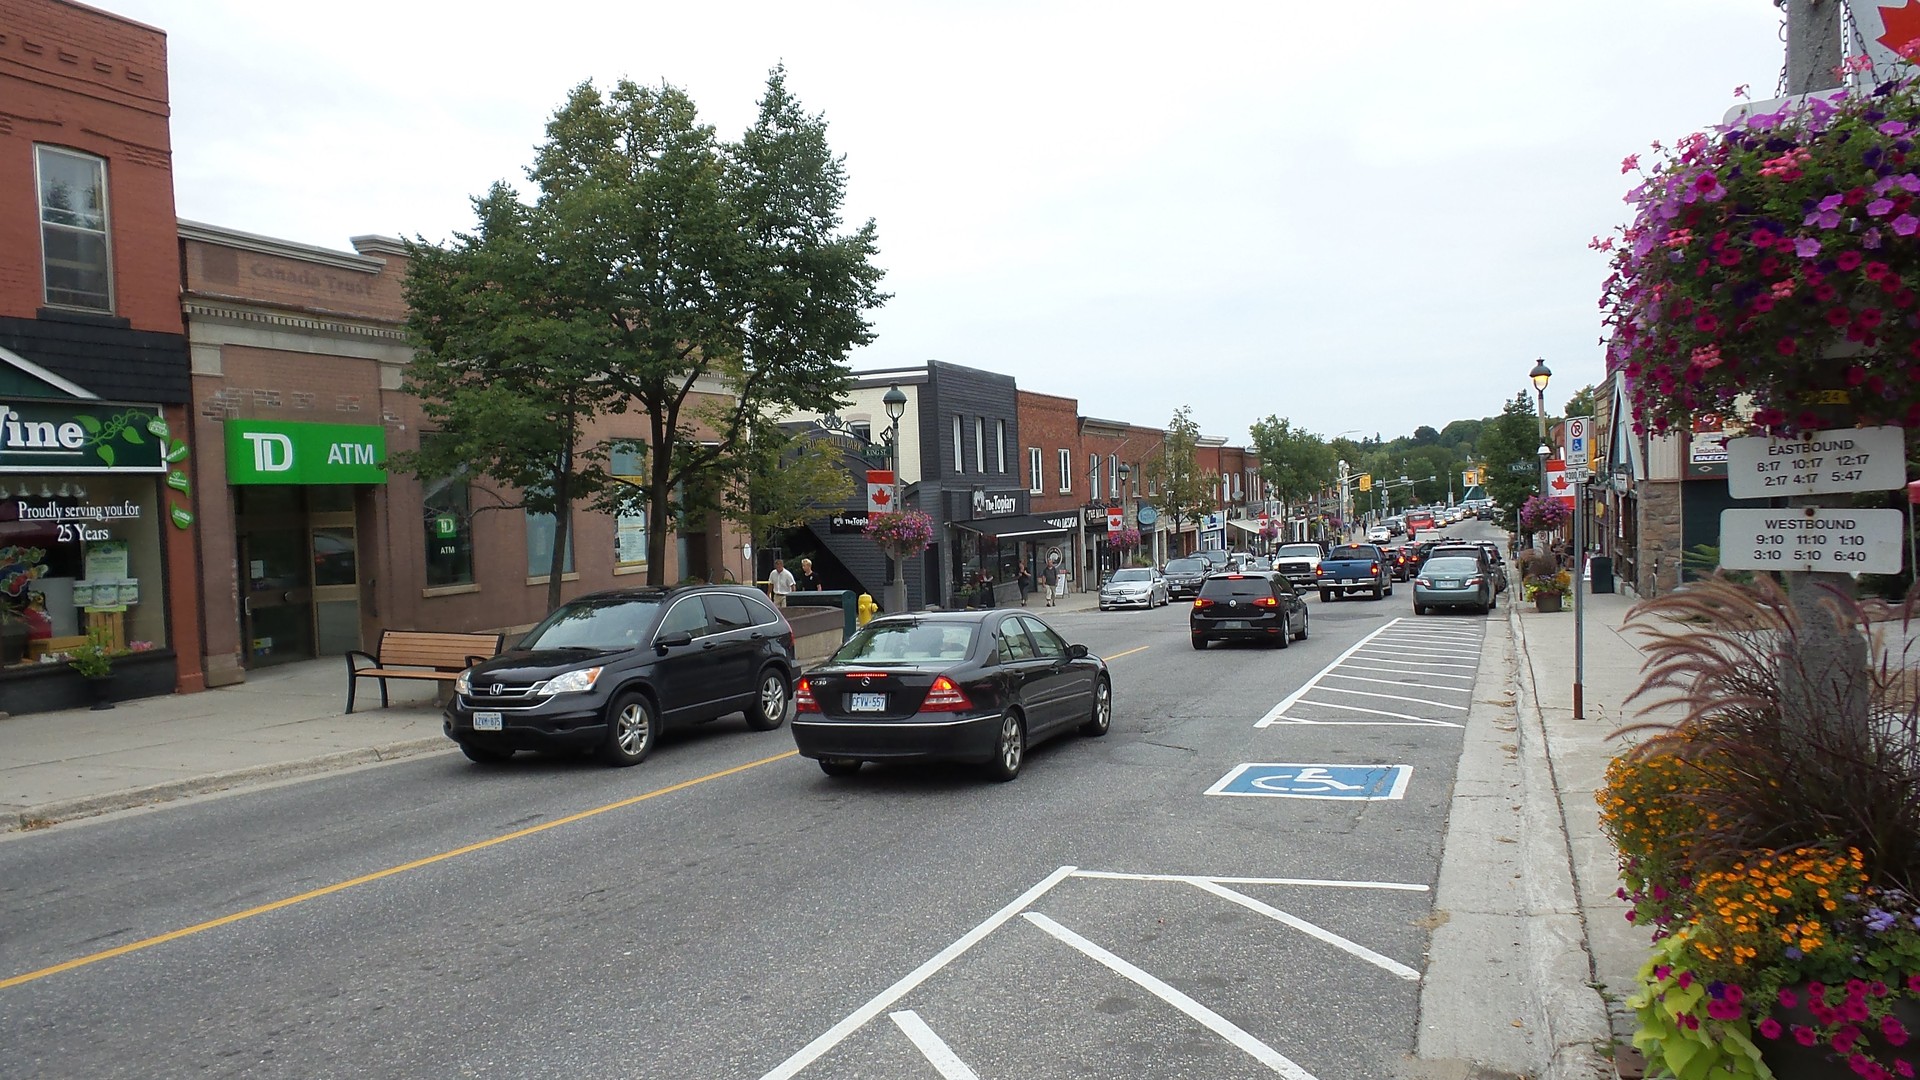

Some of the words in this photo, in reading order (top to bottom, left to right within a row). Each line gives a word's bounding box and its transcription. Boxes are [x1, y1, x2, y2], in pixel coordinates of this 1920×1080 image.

[243, 432, 293, 471] TD
[327, 443, 374, 465] ATM
[846, 438, 862, 452] PARK
[1768, 440, 1855, 456] EASTBOUND
[1757, 461, 1781, 473] 8:17
[1791, 457, 1824, 470] 10:17
[1836, 454, 1870, 466] 12:17
[1764, 475, 1788, 487] 2:17
[1793, 473, 1819, 484] 4:17
[1831, 470, 1863, 482] 5:47
[985, 499, 994, 511] The
[993, 494, 1016, 513] Topiary
[18, 501, 63, 523] Proudly
[65, 501, 102, 521] serving
[104, 506, 123, 522] you
[123, 500, 140, 516] for
[437, 518, 453, 533] TD
[852, 517, 869, 525] Topia
[1765, 519, 1856, 530] WESTBOUND
[57, 524, 73, 542] 25
[73, 524, 109, 541] Years
[1756, 534, 1784, 545] 9:10
[1796, 534, 1827, 545] 11:10
[1839, 535, 1864, 546] 1:10
[440, 546, 455, 554] ATM
[1754, 550, 1781, 560] 3:10
[1793, 550, 1822, 561] 5:10
[1834, 551, 1866, 562] 6:40
